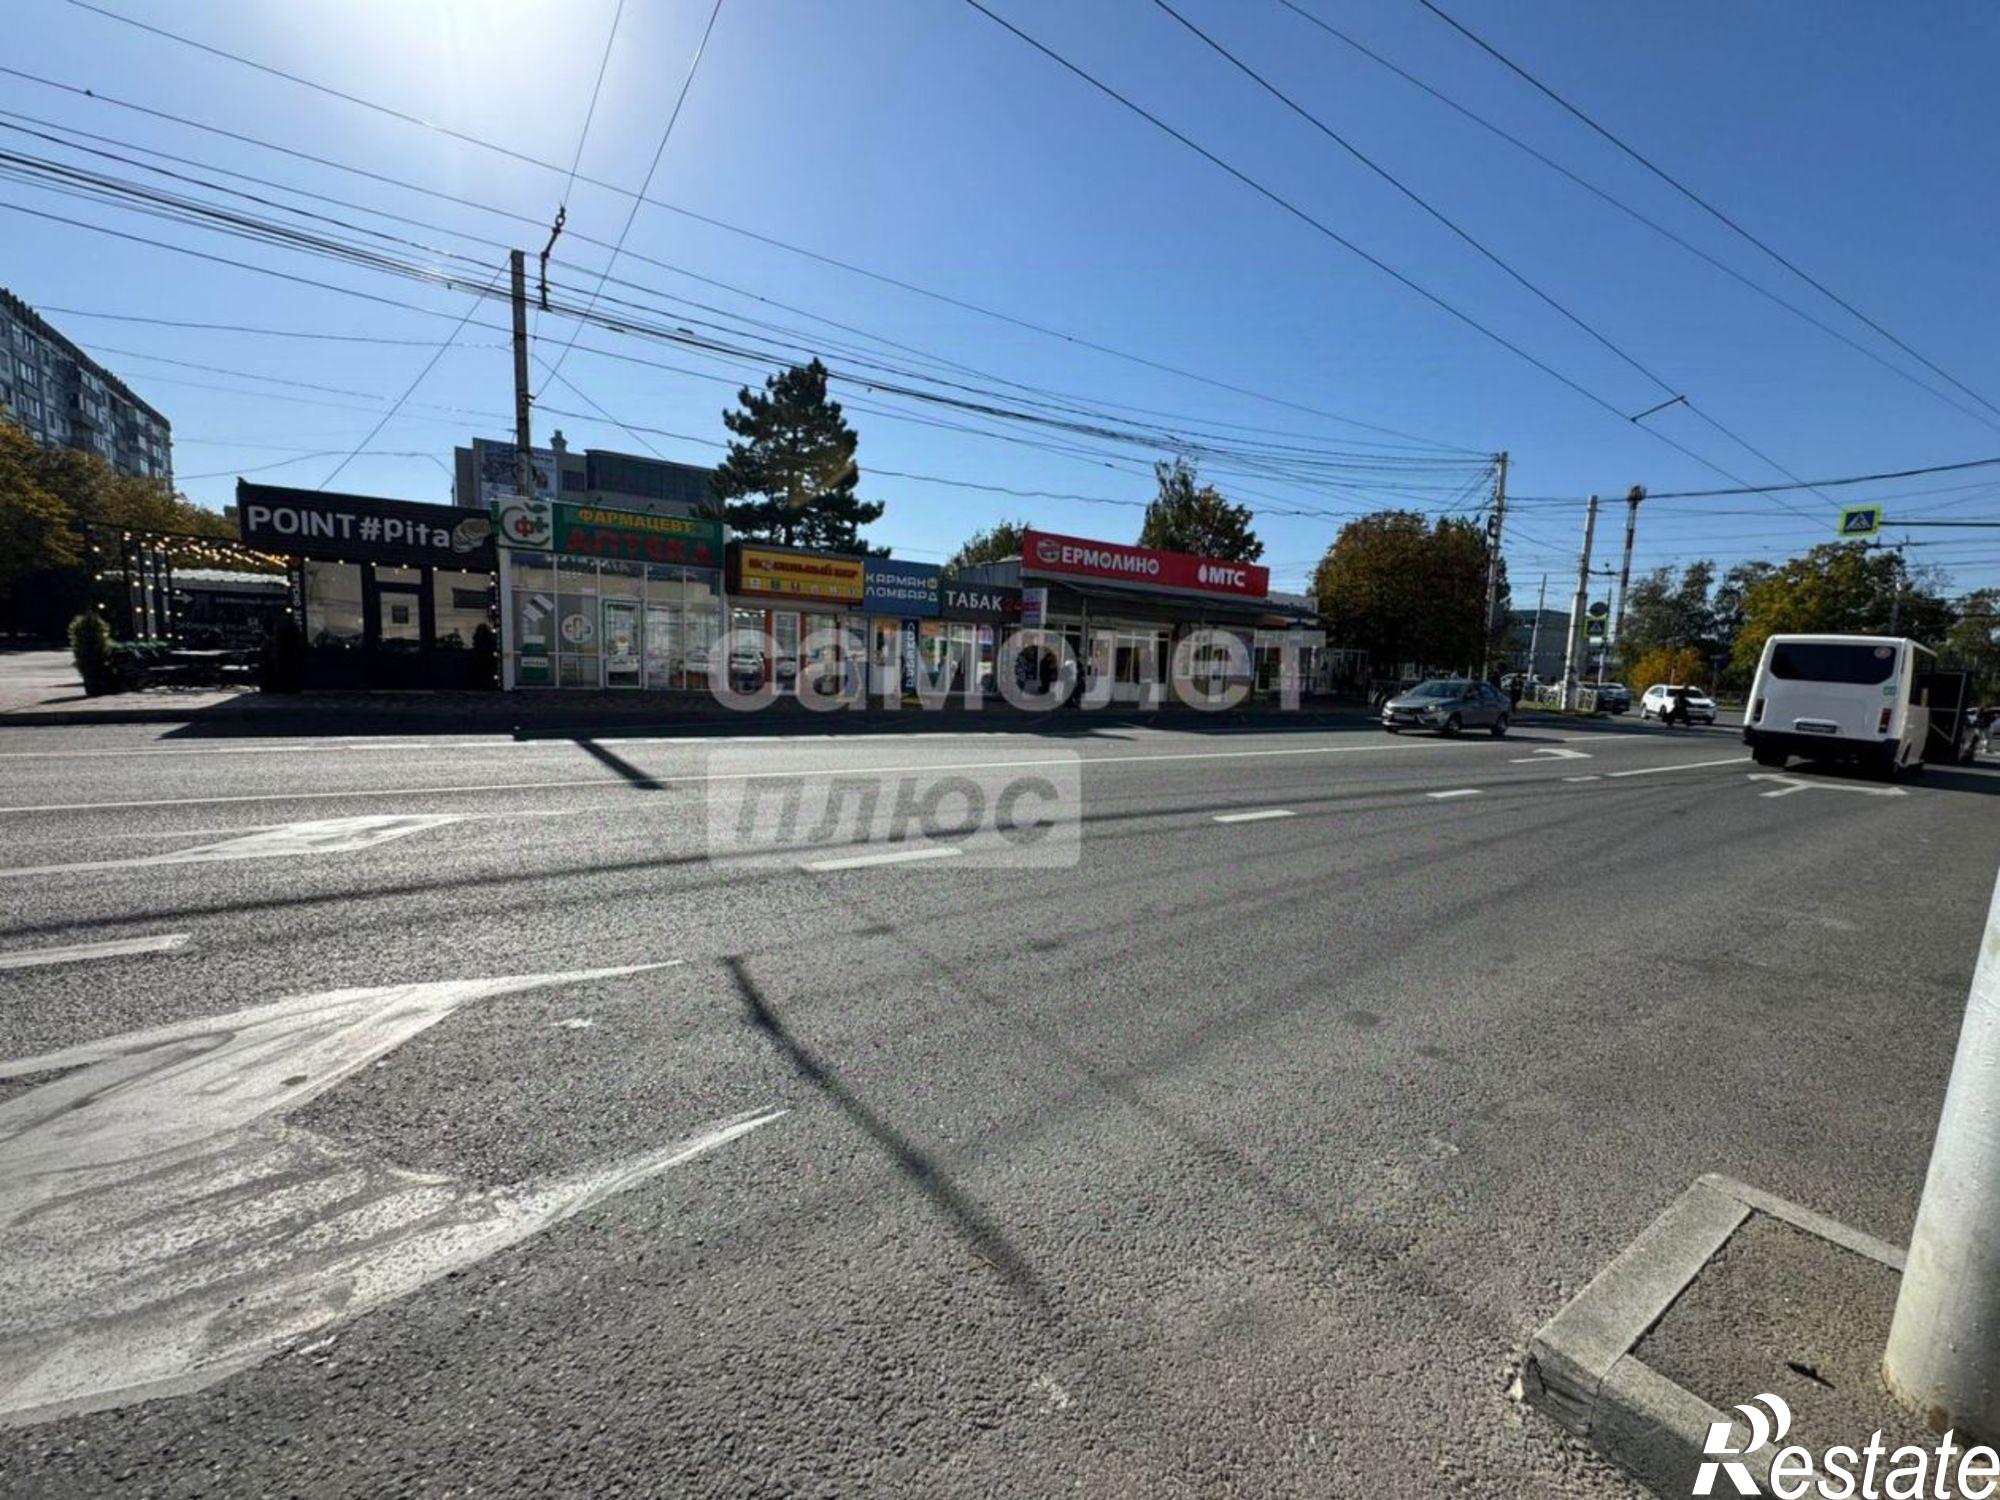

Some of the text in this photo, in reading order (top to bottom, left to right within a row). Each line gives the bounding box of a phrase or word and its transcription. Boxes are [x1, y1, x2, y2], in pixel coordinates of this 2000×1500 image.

[247, 505, 356, 539] POINT
[578, 508, 696, 533] ФАРМАЦЕВТ
[567, 527, 714, 565] АПТЕКА
[1061, 546, 1160, 575] ЕРМОЛИНО
[1208, 567, 1246, 588] МТС
[865, 586, 938, 602] ЛОМБАРД
[946, 590, 1003, 611] ТАБАК
